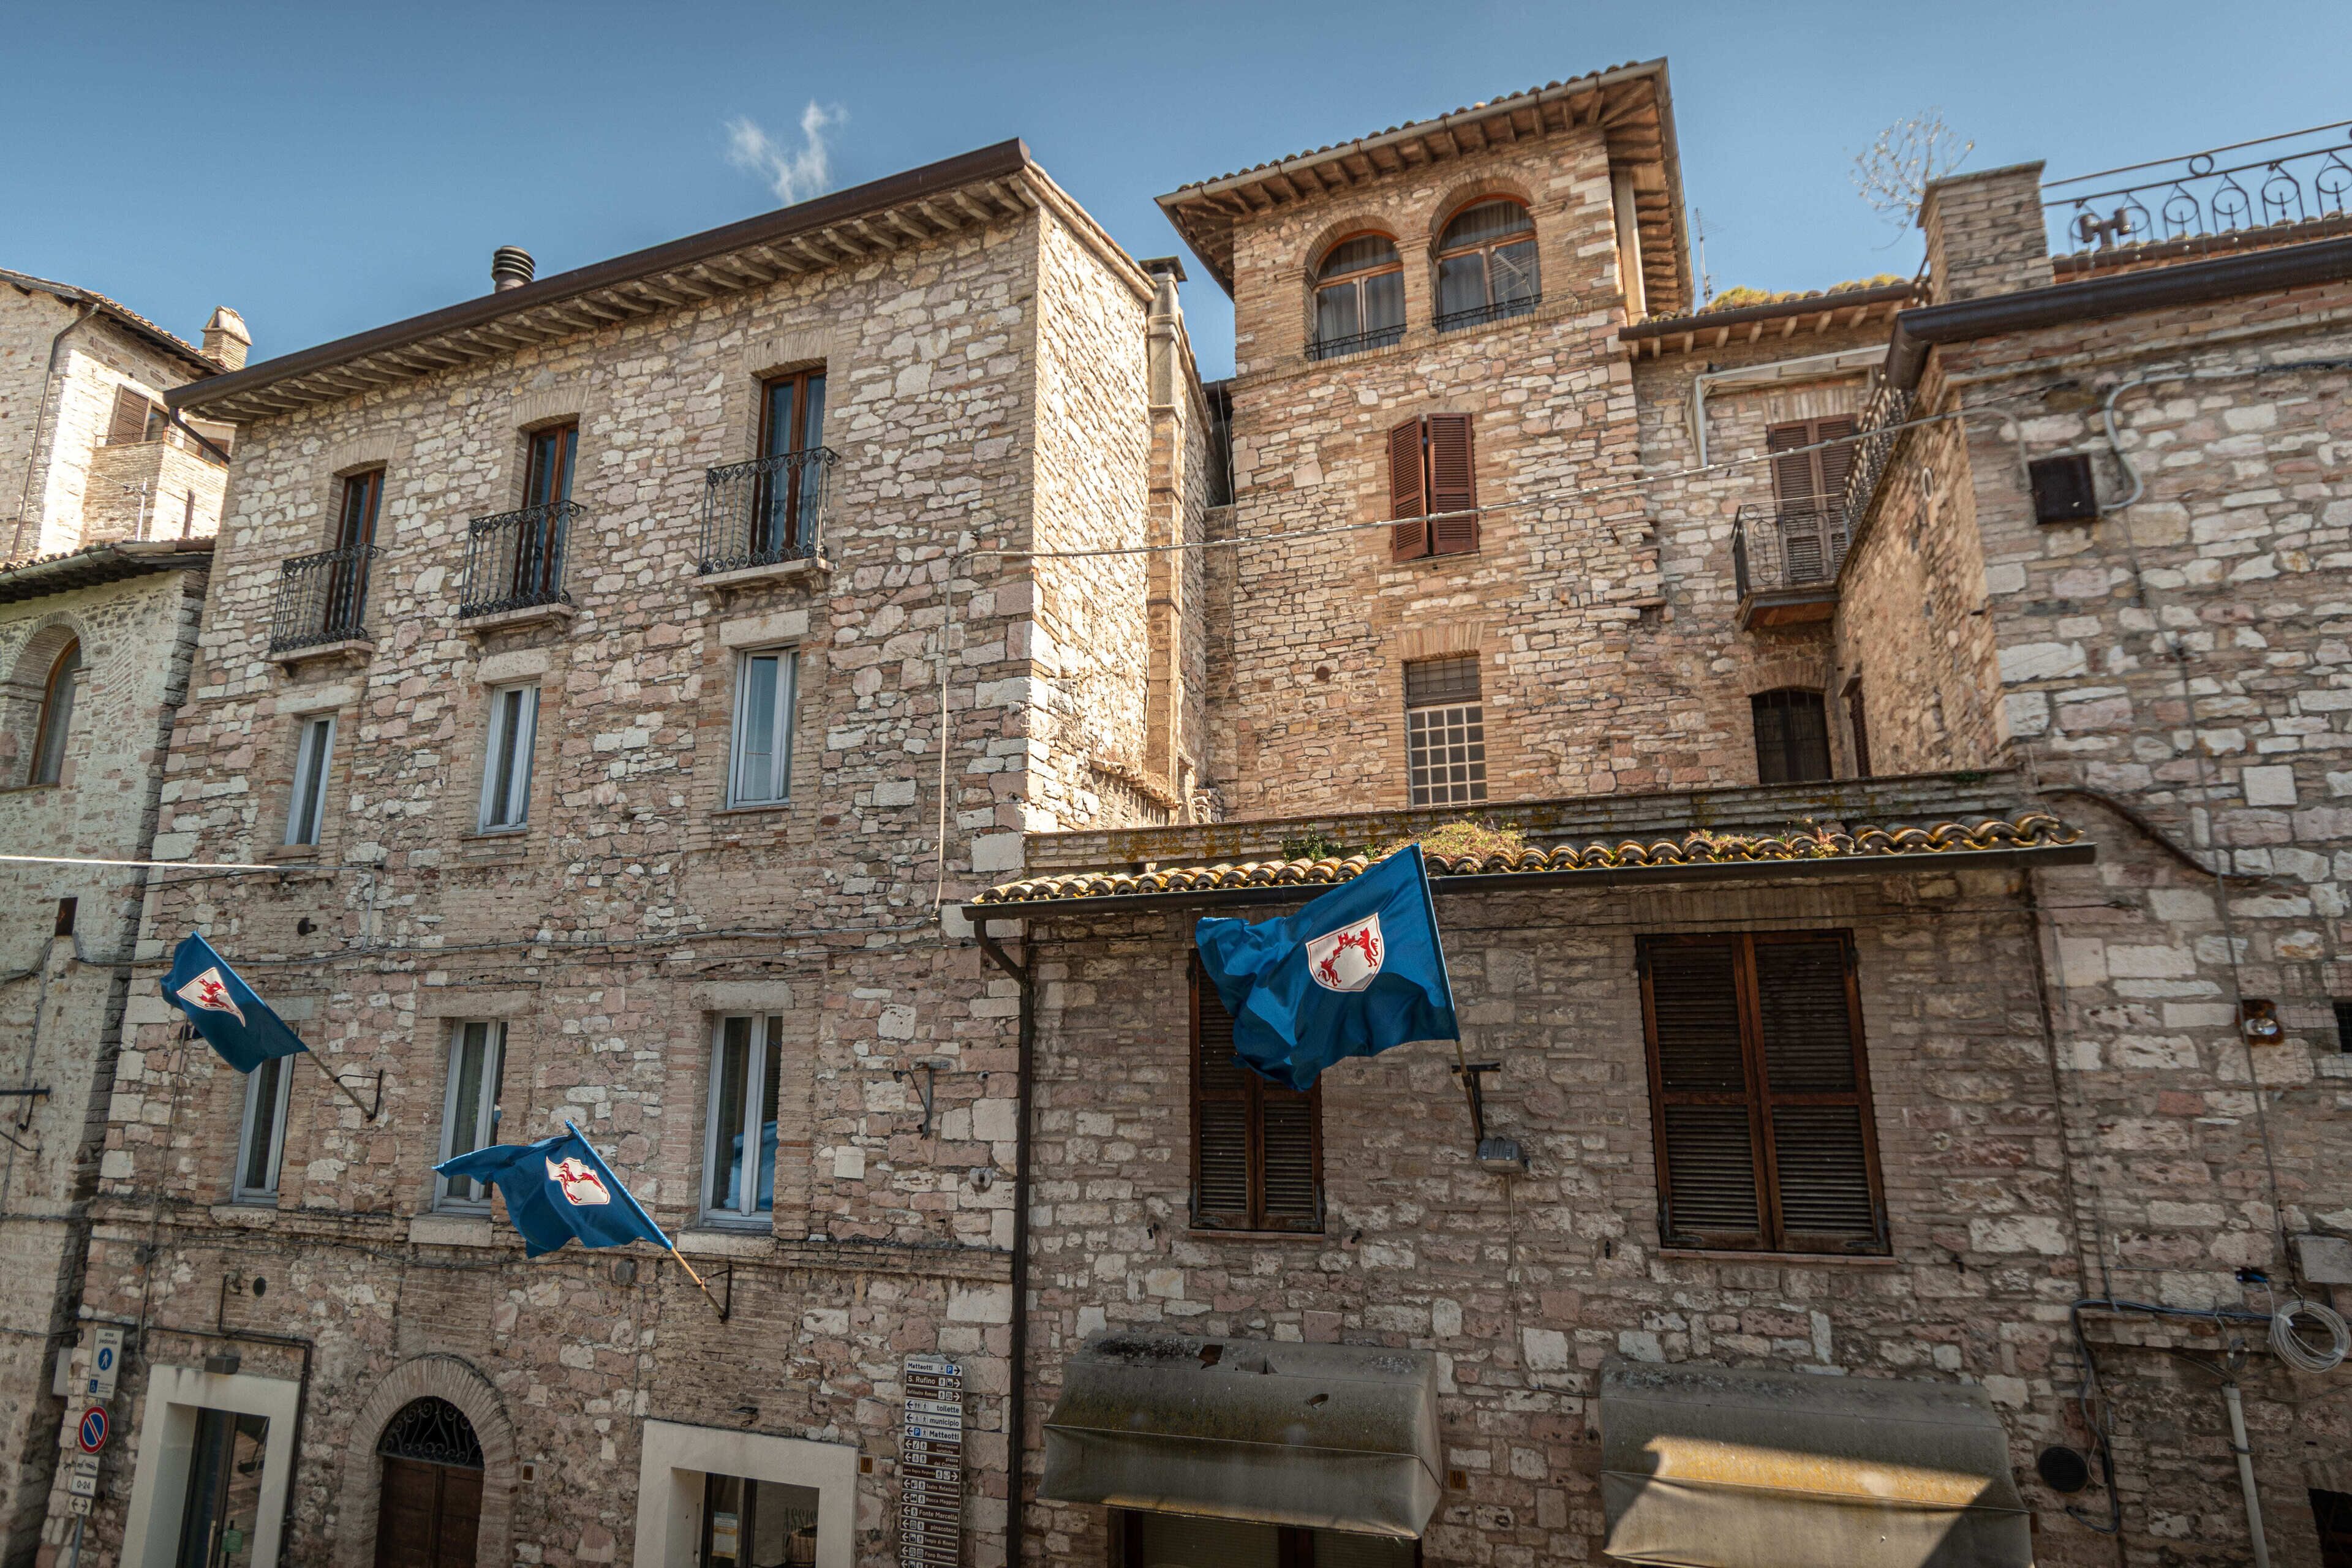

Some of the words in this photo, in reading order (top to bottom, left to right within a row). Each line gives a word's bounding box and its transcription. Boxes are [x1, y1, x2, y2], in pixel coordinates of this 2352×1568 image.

[930, 1418, 959, 1427] municipio
[930, 1430, 959, 1440] Matteotti
[77, 1480, 91, 1490] 0-24
[930, 1525, 957, 1534] pinacoteca
[937, 1553, 956, 1561] Romano
